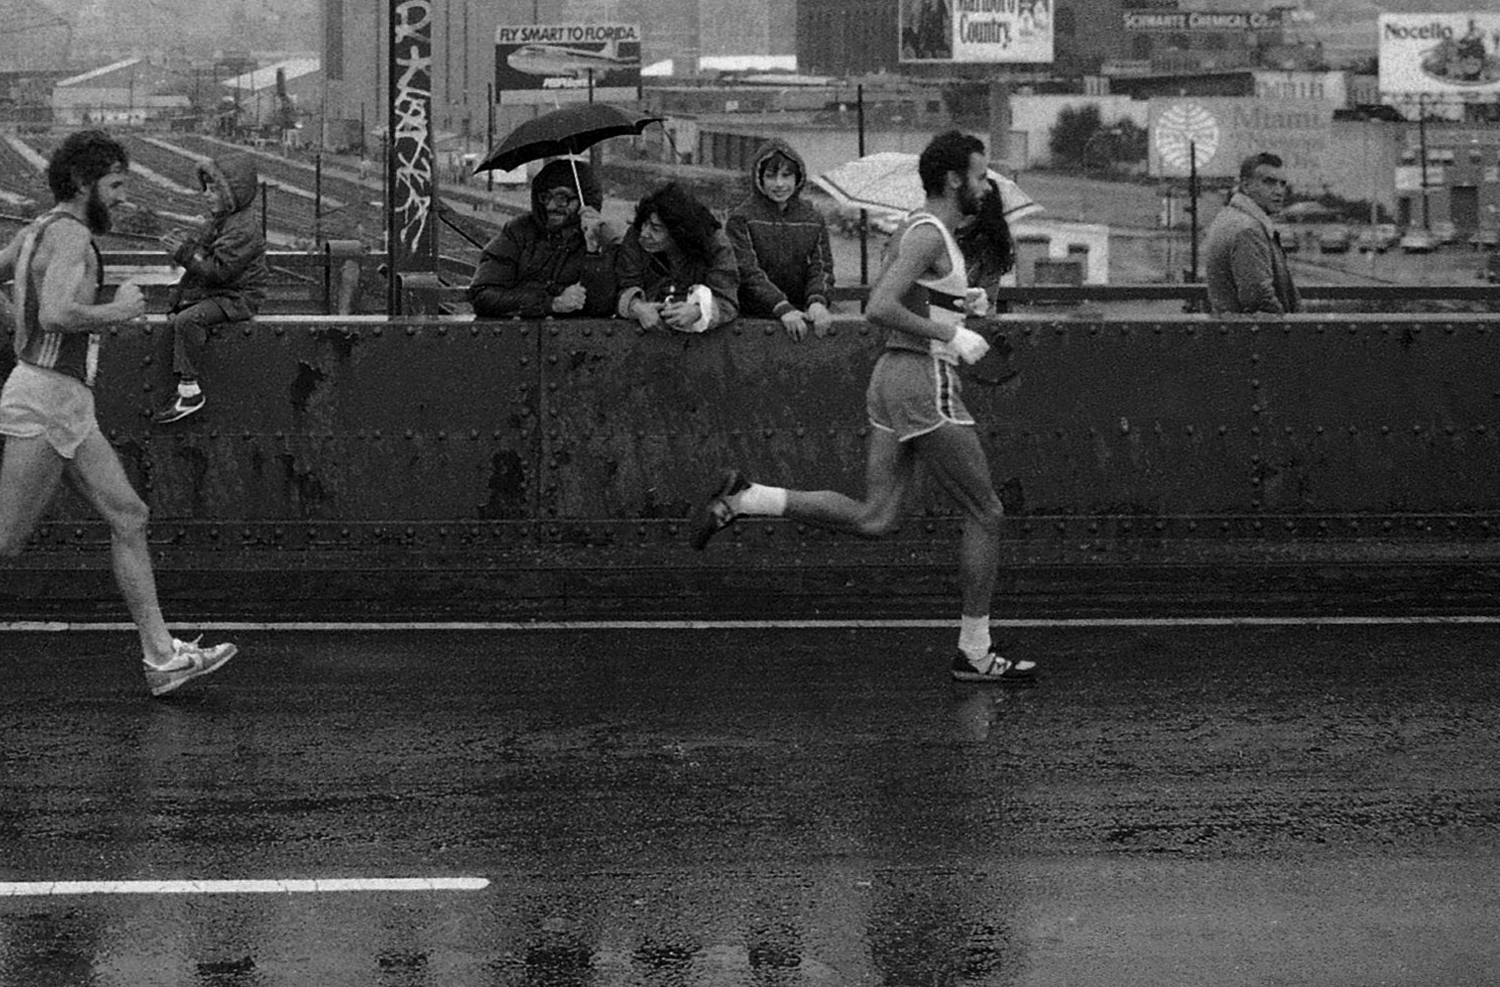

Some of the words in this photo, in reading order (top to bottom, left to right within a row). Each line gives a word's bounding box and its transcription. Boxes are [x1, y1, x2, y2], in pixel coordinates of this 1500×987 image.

[499, 27, 519, 41] FLY
[520, 27, 564, 41] SMART
[566, 26, 584, 41] TO
[1384, 22, 1452, 40] Nocello
